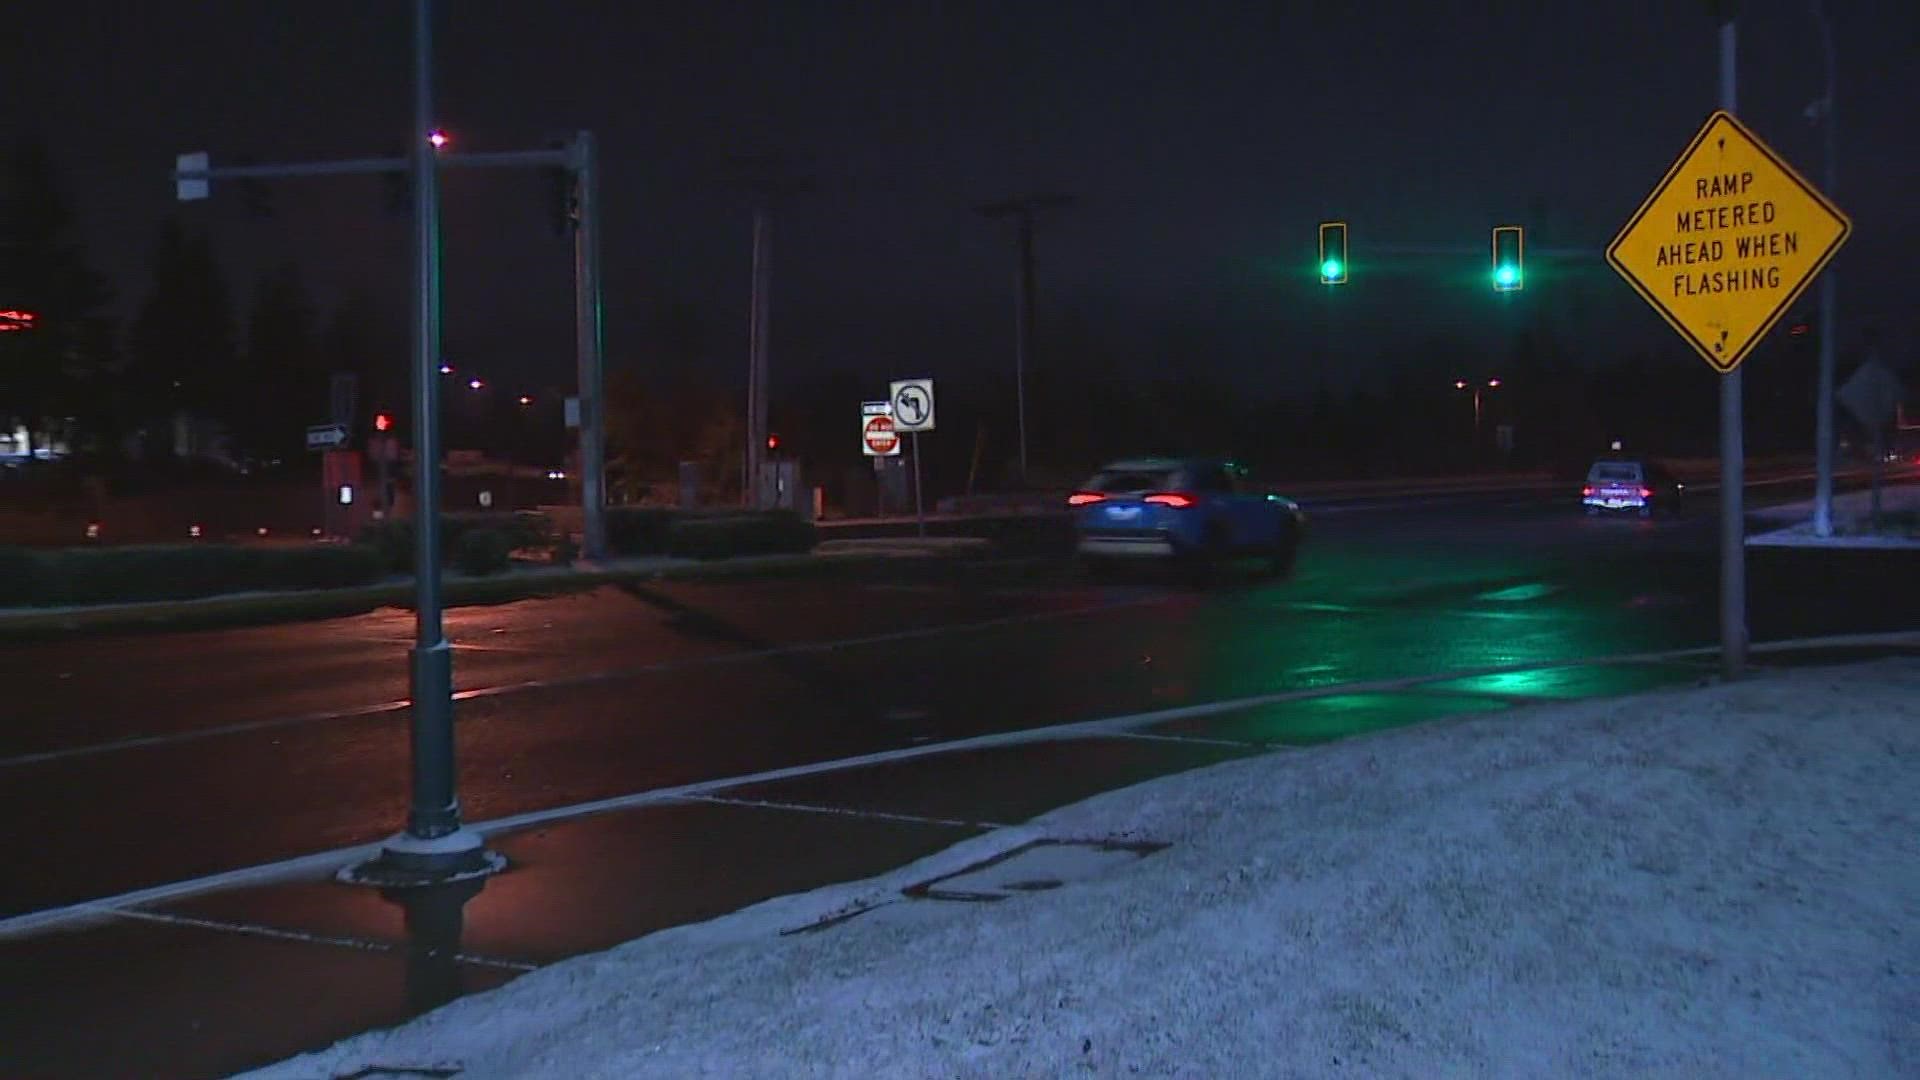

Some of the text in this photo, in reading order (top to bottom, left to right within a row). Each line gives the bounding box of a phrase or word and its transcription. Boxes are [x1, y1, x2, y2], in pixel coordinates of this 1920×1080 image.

[1696, 172, 1753, 199] RAMP
[1677, 201, 1775, 233] METERED
[1656, 231, 1797, 267] AHEAD WHEN
[1674, 266, 1780, 297] FLASHING
